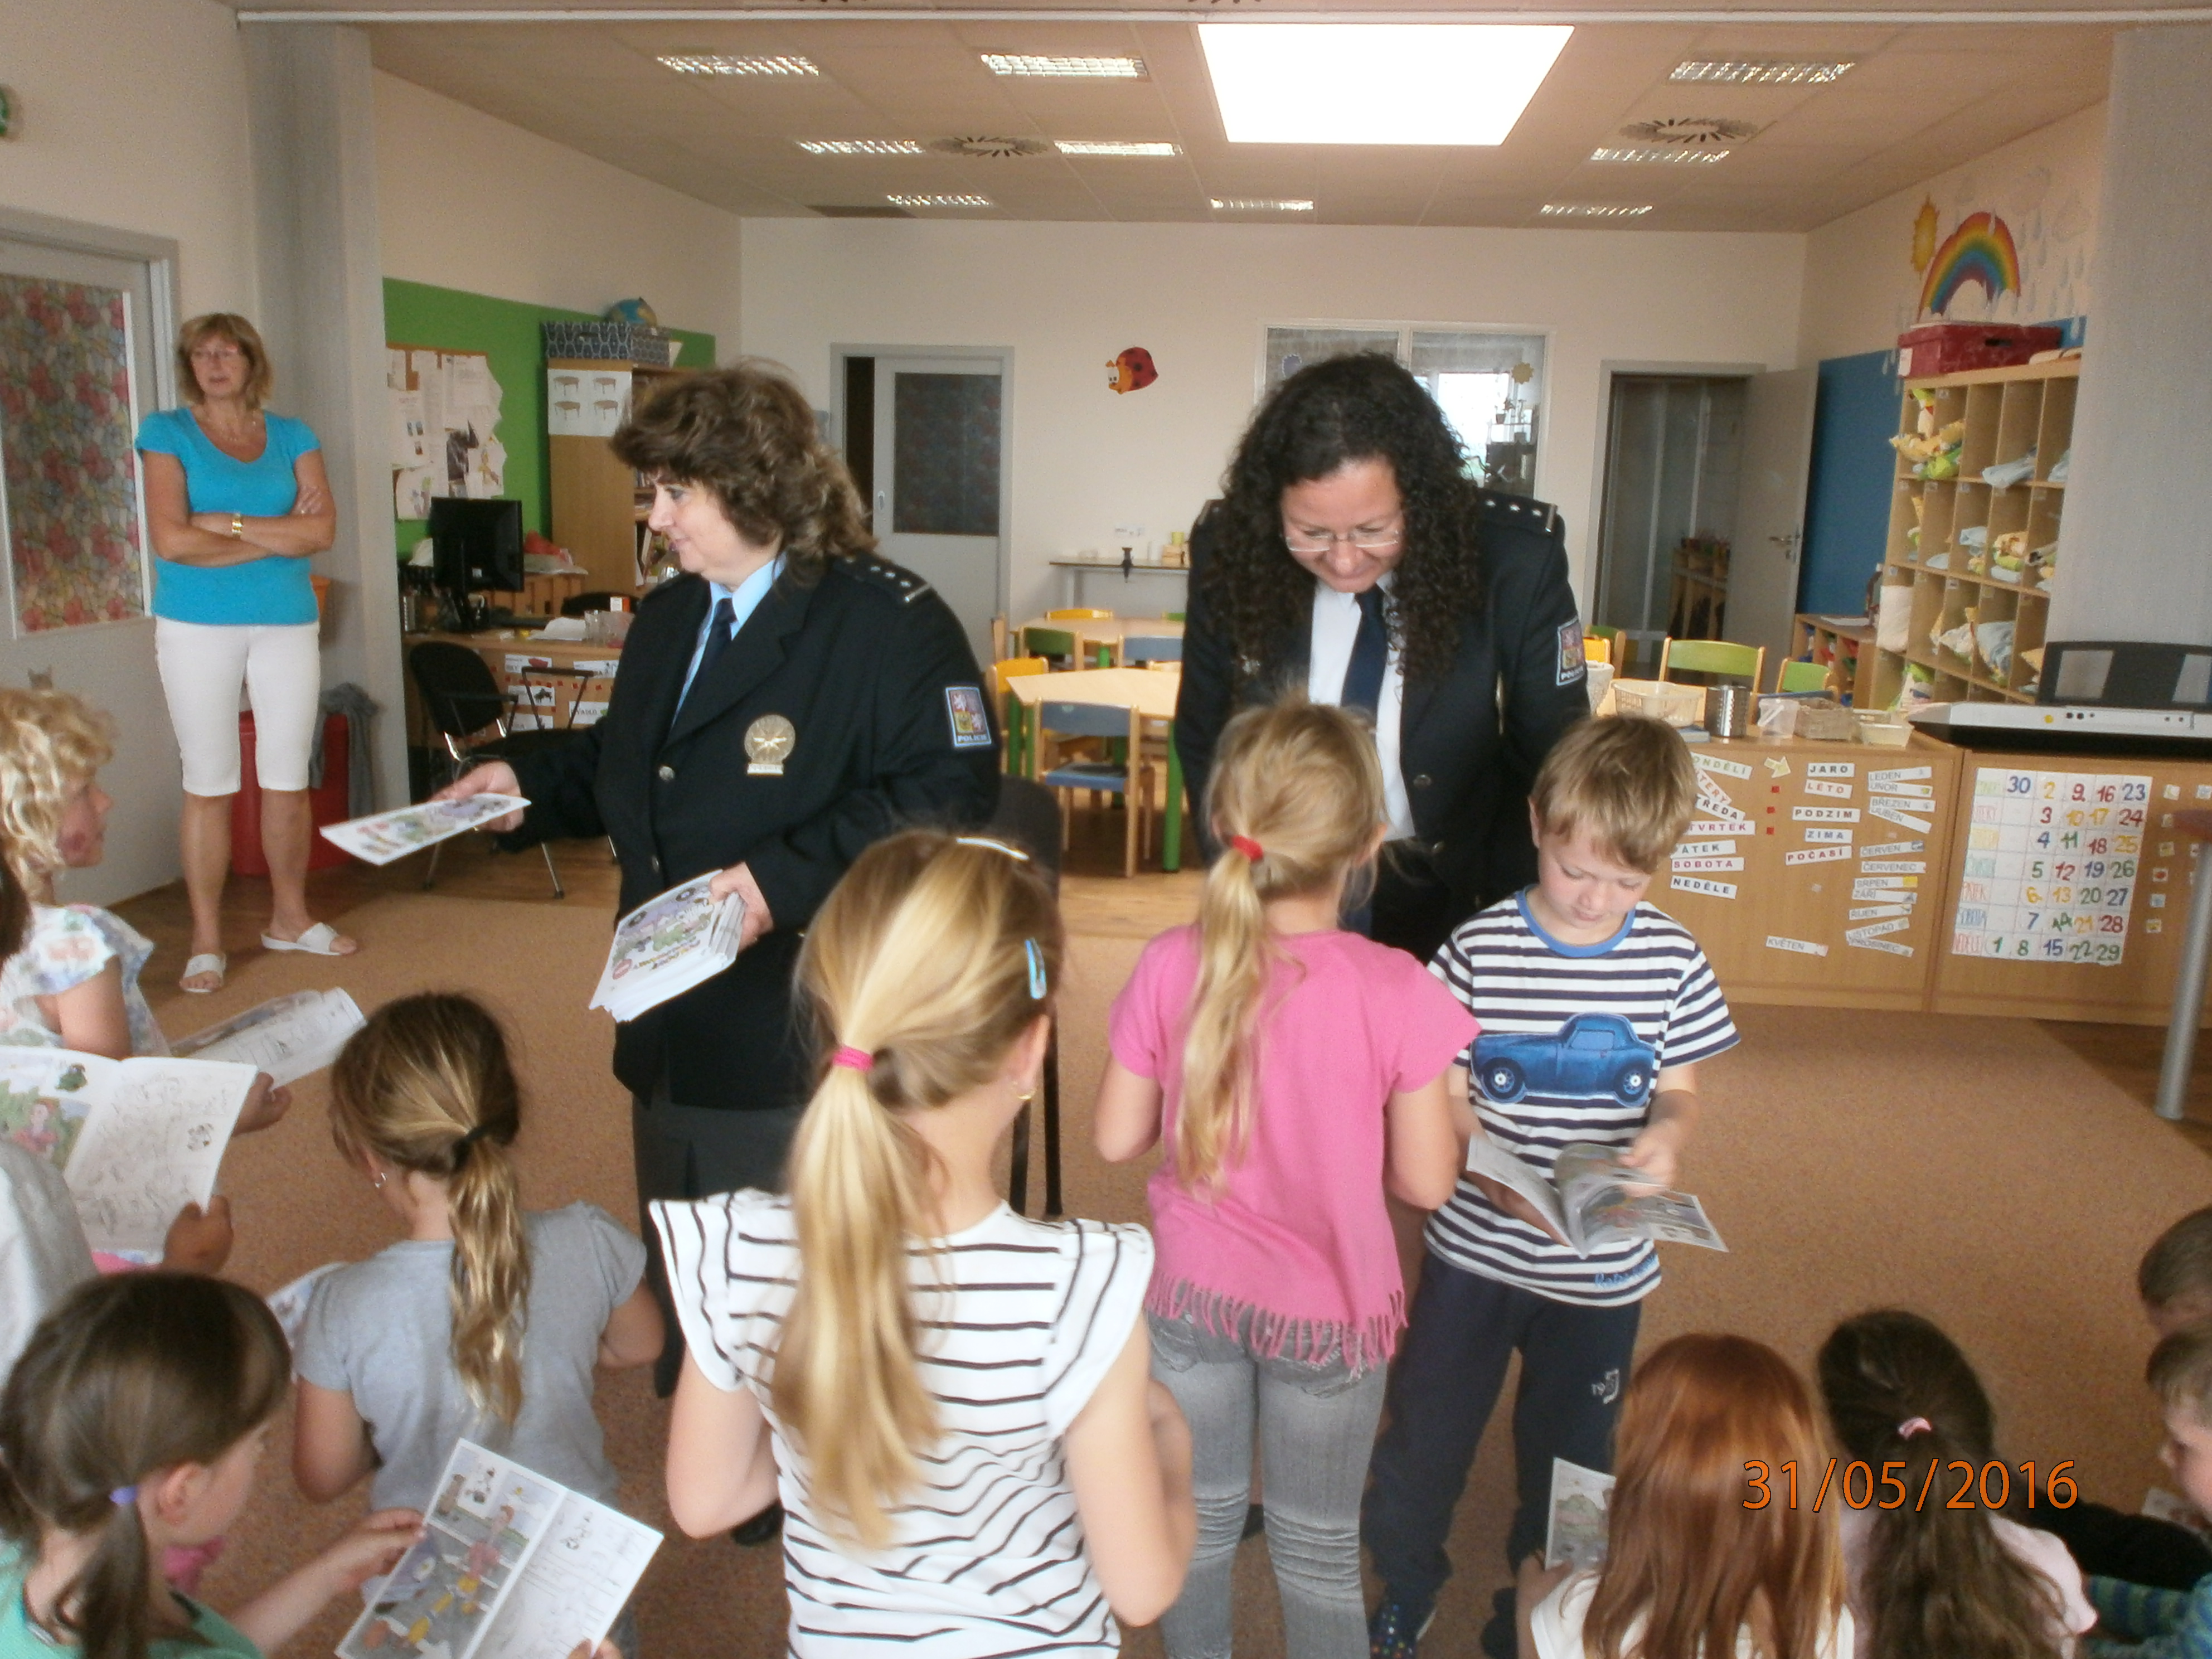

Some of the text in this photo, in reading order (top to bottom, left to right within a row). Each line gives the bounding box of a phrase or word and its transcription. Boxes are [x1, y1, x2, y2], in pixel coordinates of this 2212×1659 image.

[1869, 772, 1901, 780] LEDEN
[1808, 783, 1844, 793] LÉTO
[2007, 776, 2031, 794] 30
[2044, 782, 2055, 799] 2
[2097, 785, 2116, 802] 16
[2122, 783, 2146, 801] 23
[1795, 809, 1852, 818] PODZIM
[2040, 807, 2052, 823] 3
[2067, 810, 2085, 826] 10
[2090, 808, 2109, 826] 17
[2119, 809, 2143, 827] 24
[1807, 831, 1844, 840] ZIMA
[2037, 831, 2138, 854] 4 11 18 25
[1682, 844, 1719, 853] ÁTEK
[1788, 847, 1842, 862] POČASÍ
[2031, 860, 2135, 881] 5 12 19 26
[1673, 878, 1730, 894] NEDĚLE
[1856, 879, 1888, 888] SRPEN
[2053, 886, 2072, 903] 13
[2080, 887, 2102, 904] 20
[2106, 887, 2128, 906] 27
[2027, 911, 2039, 930] 7
[2051, 912, 2072, 933] 14
[2074, 915, 2094, 934] 21
[2098, 915, 2123, 933] 28
[1768, 938, 1804, 950] KVĚTEN
[1993, 937, 2003, 953] 1
[2017, 940, 2029, 956] 8
[2043, 938, 2063, 957] 15
[2069, 940, 2093, 961] 22
[2096, 944, 2121, 961] 29
